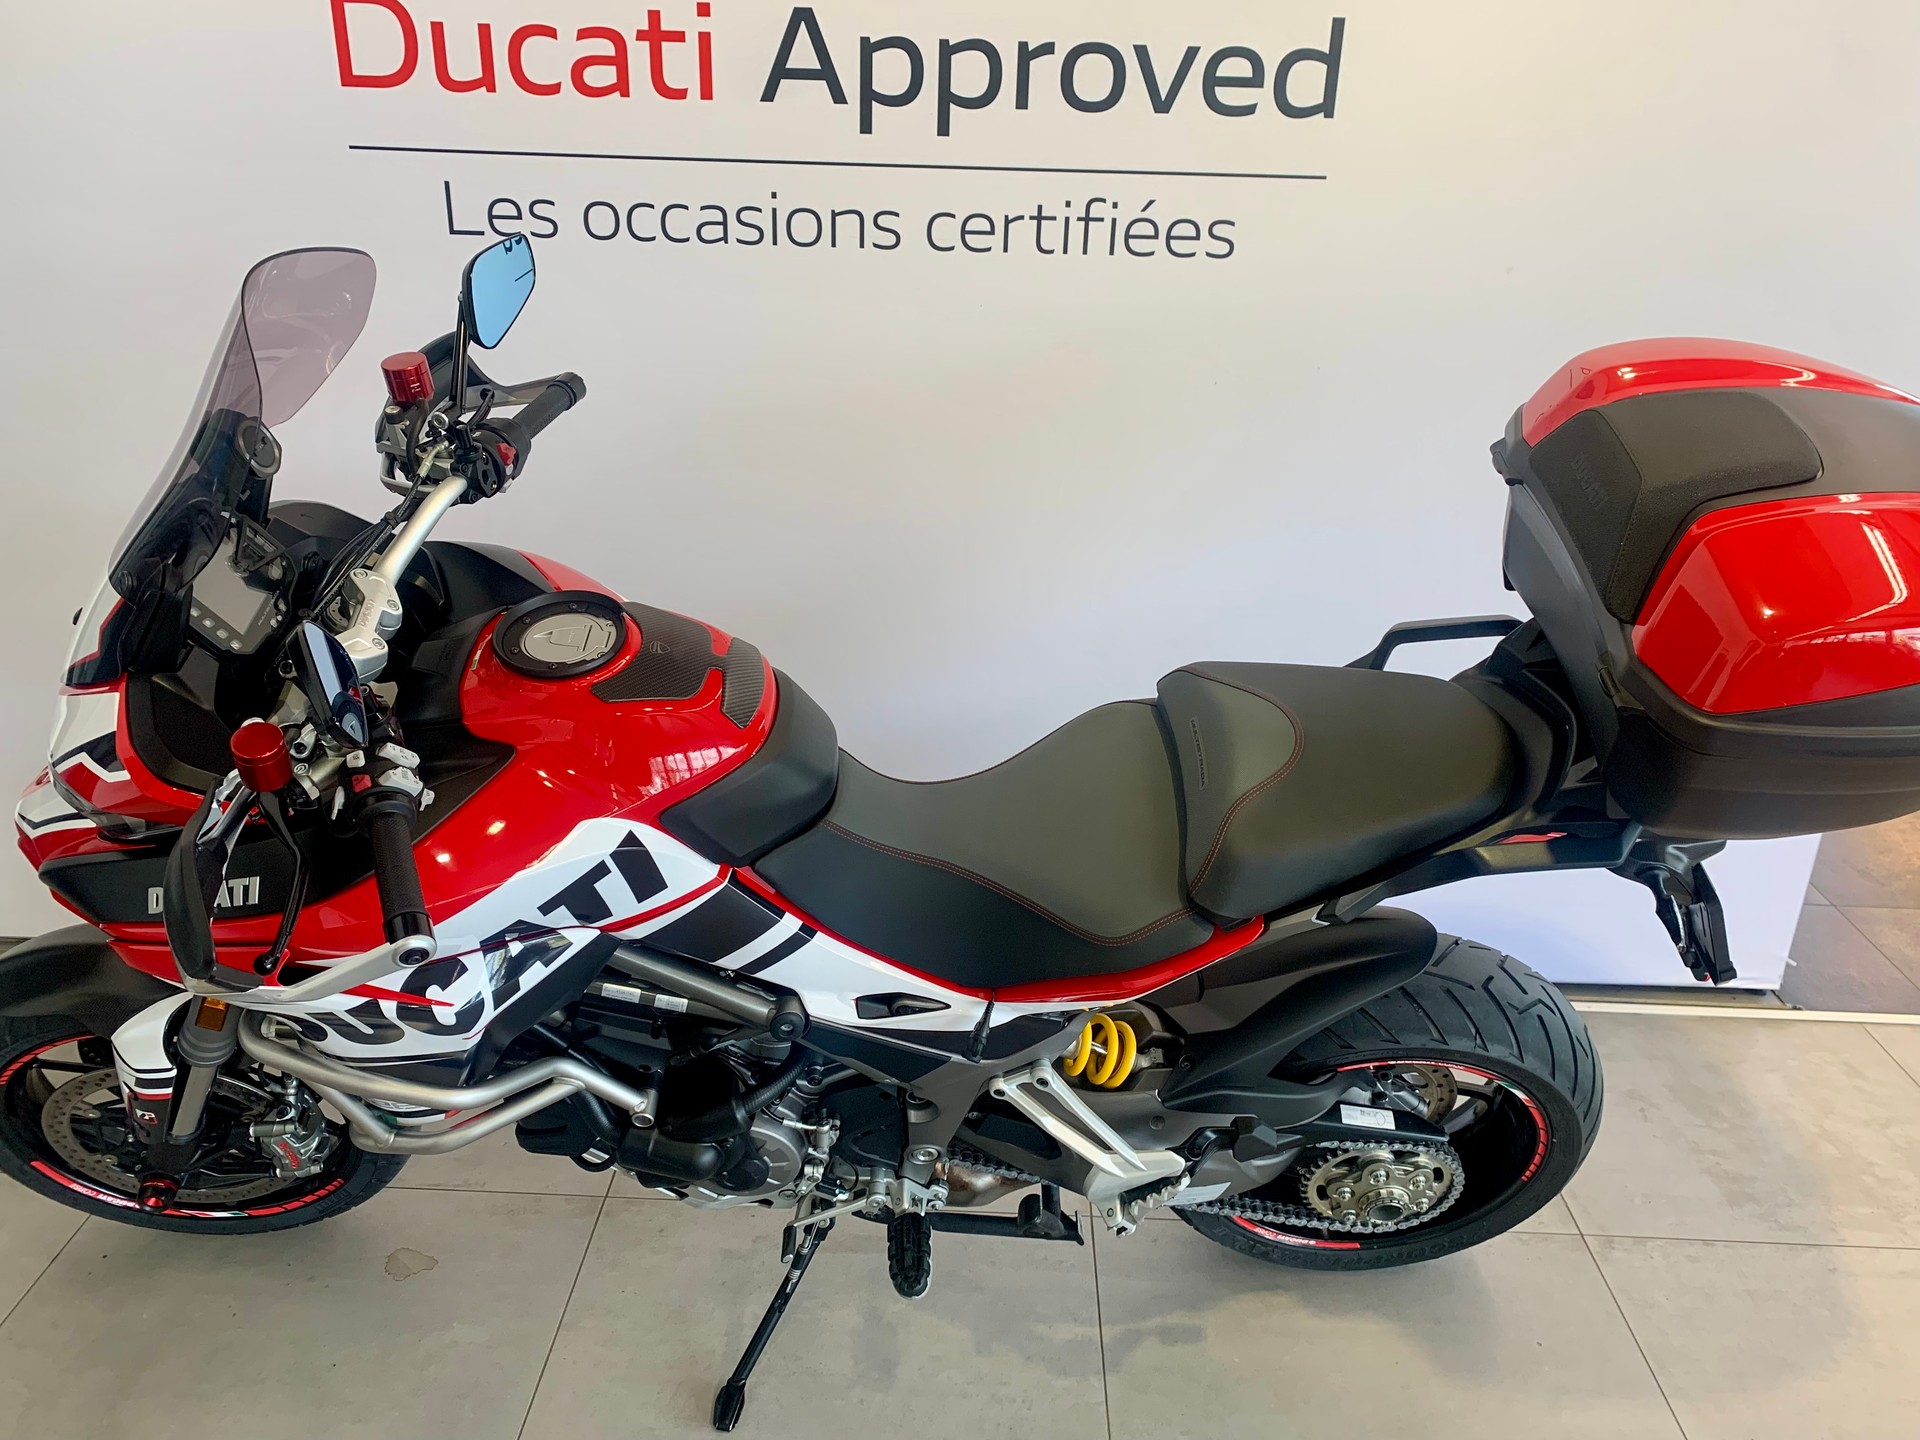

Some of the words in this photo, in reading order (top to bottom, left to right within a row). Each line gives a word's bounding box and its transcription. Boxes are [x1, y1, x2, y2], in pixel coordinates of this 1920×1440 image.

[329, 0, 713, 101] Ducati
[760, 6, 1346, 137] Approved
[443, 180, 559, 239] Les
[583, 190, 901, 251] occasions
[926, 197, 1236, 259] certifiées
[147, 876, 260, 915] DATI
